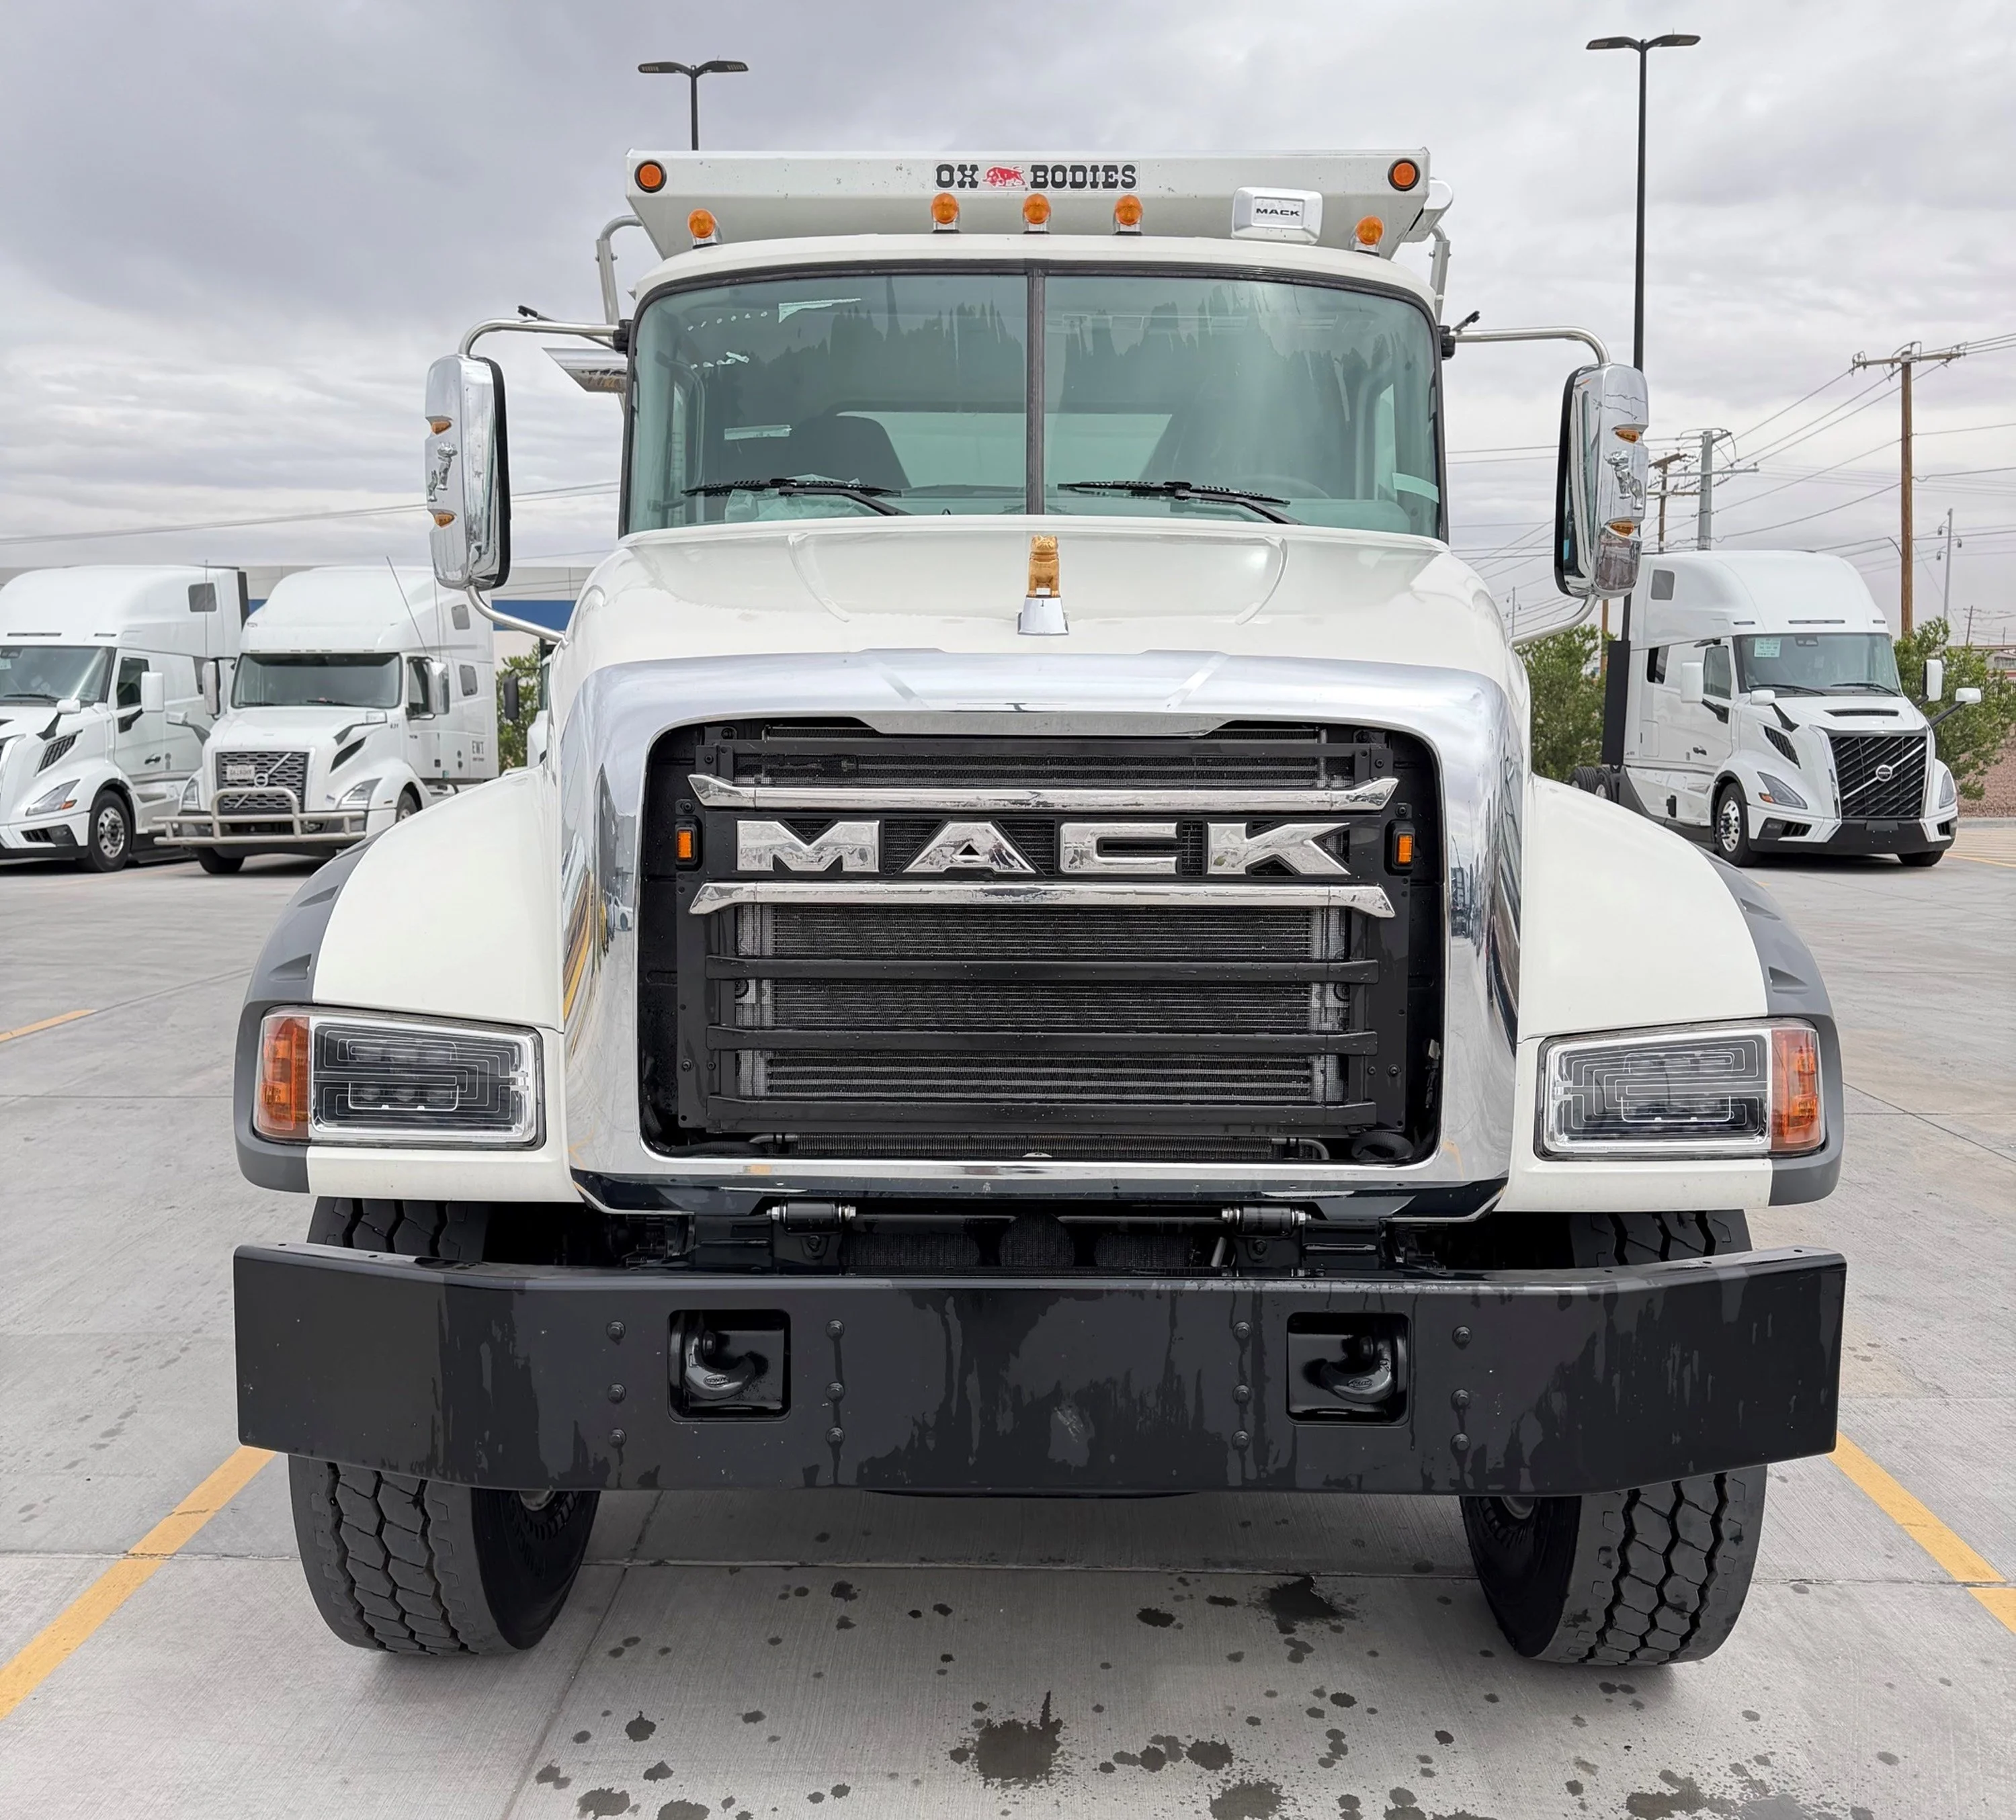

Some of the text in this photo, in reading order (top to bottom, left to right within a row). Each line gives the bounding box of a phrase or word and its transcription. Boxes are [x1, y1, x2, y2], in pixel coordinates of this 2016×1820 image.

[935, 164, 1136, 189] OX BODIES
[1256, 208, 1300, 216] MACK
[737, 820, 1351, 875] MACK
